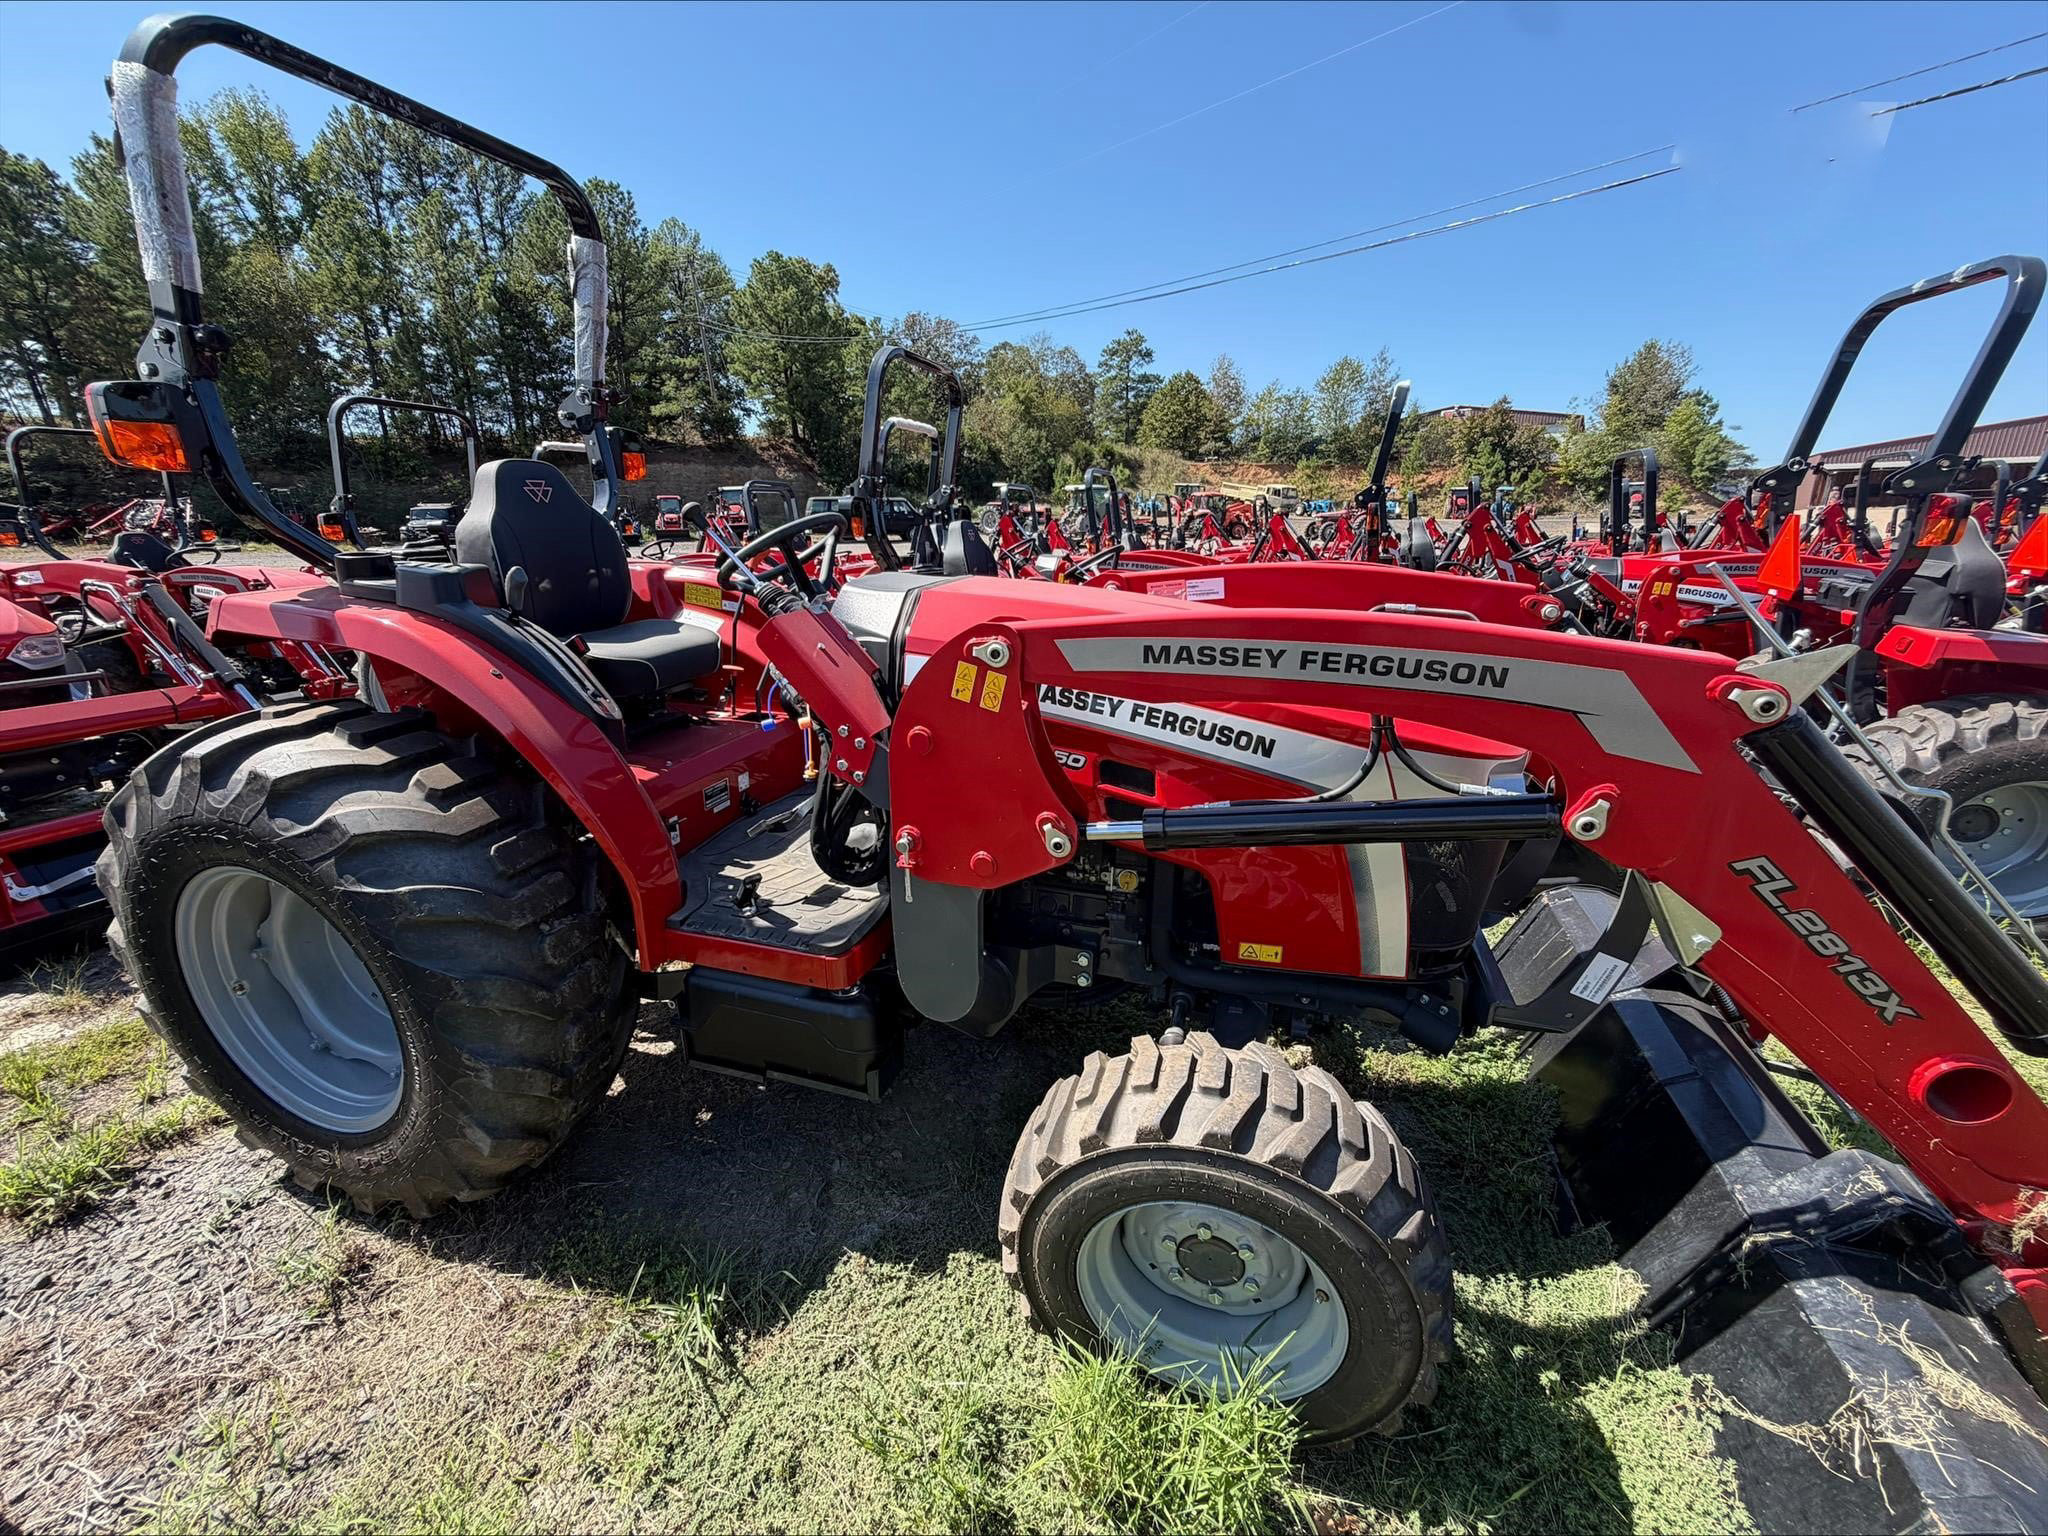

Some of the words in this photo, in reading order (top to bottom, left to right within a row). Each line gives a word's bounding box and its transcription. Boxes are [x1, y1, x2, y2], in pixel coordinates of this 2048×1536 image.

[1722, 563, 1759, 572] MASS
[1678, 587, 1728, 601] ERGUSON
[1142, 644, 1287, 669] MASSEY
[1300, 650, 1510, 688] FERGUSON
[1038, 684, 1124, 718] ASSEY
[1129, 703, 1277, 759] FERGUSON
